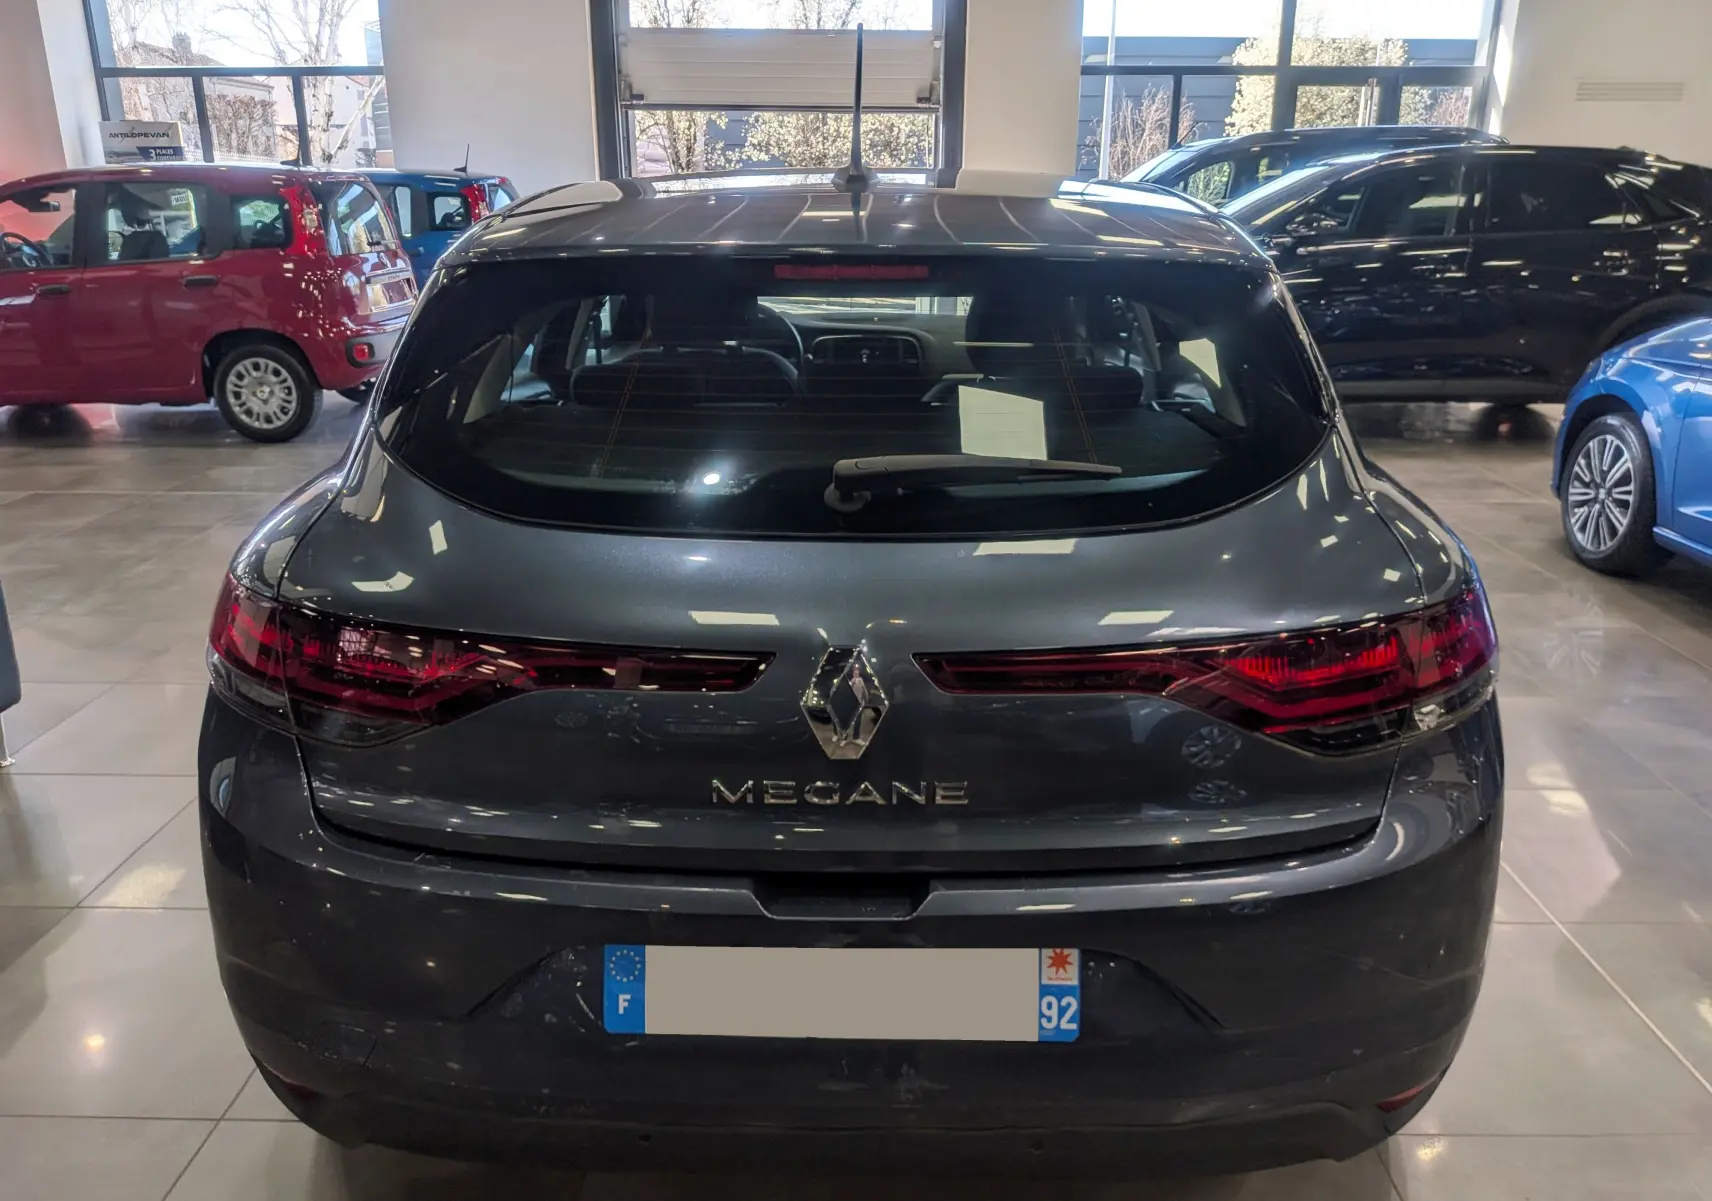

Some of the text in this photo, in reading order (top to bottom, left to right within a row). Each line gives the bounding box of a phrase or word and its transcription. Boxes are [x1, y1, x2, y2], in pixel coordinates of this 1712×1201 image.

[149, 149, 156, 161] 3
[711, 779, 969, 805] MEGANE
[618, 994, 632, 1015] F
[1040, 995, 1078, 1030] 92
